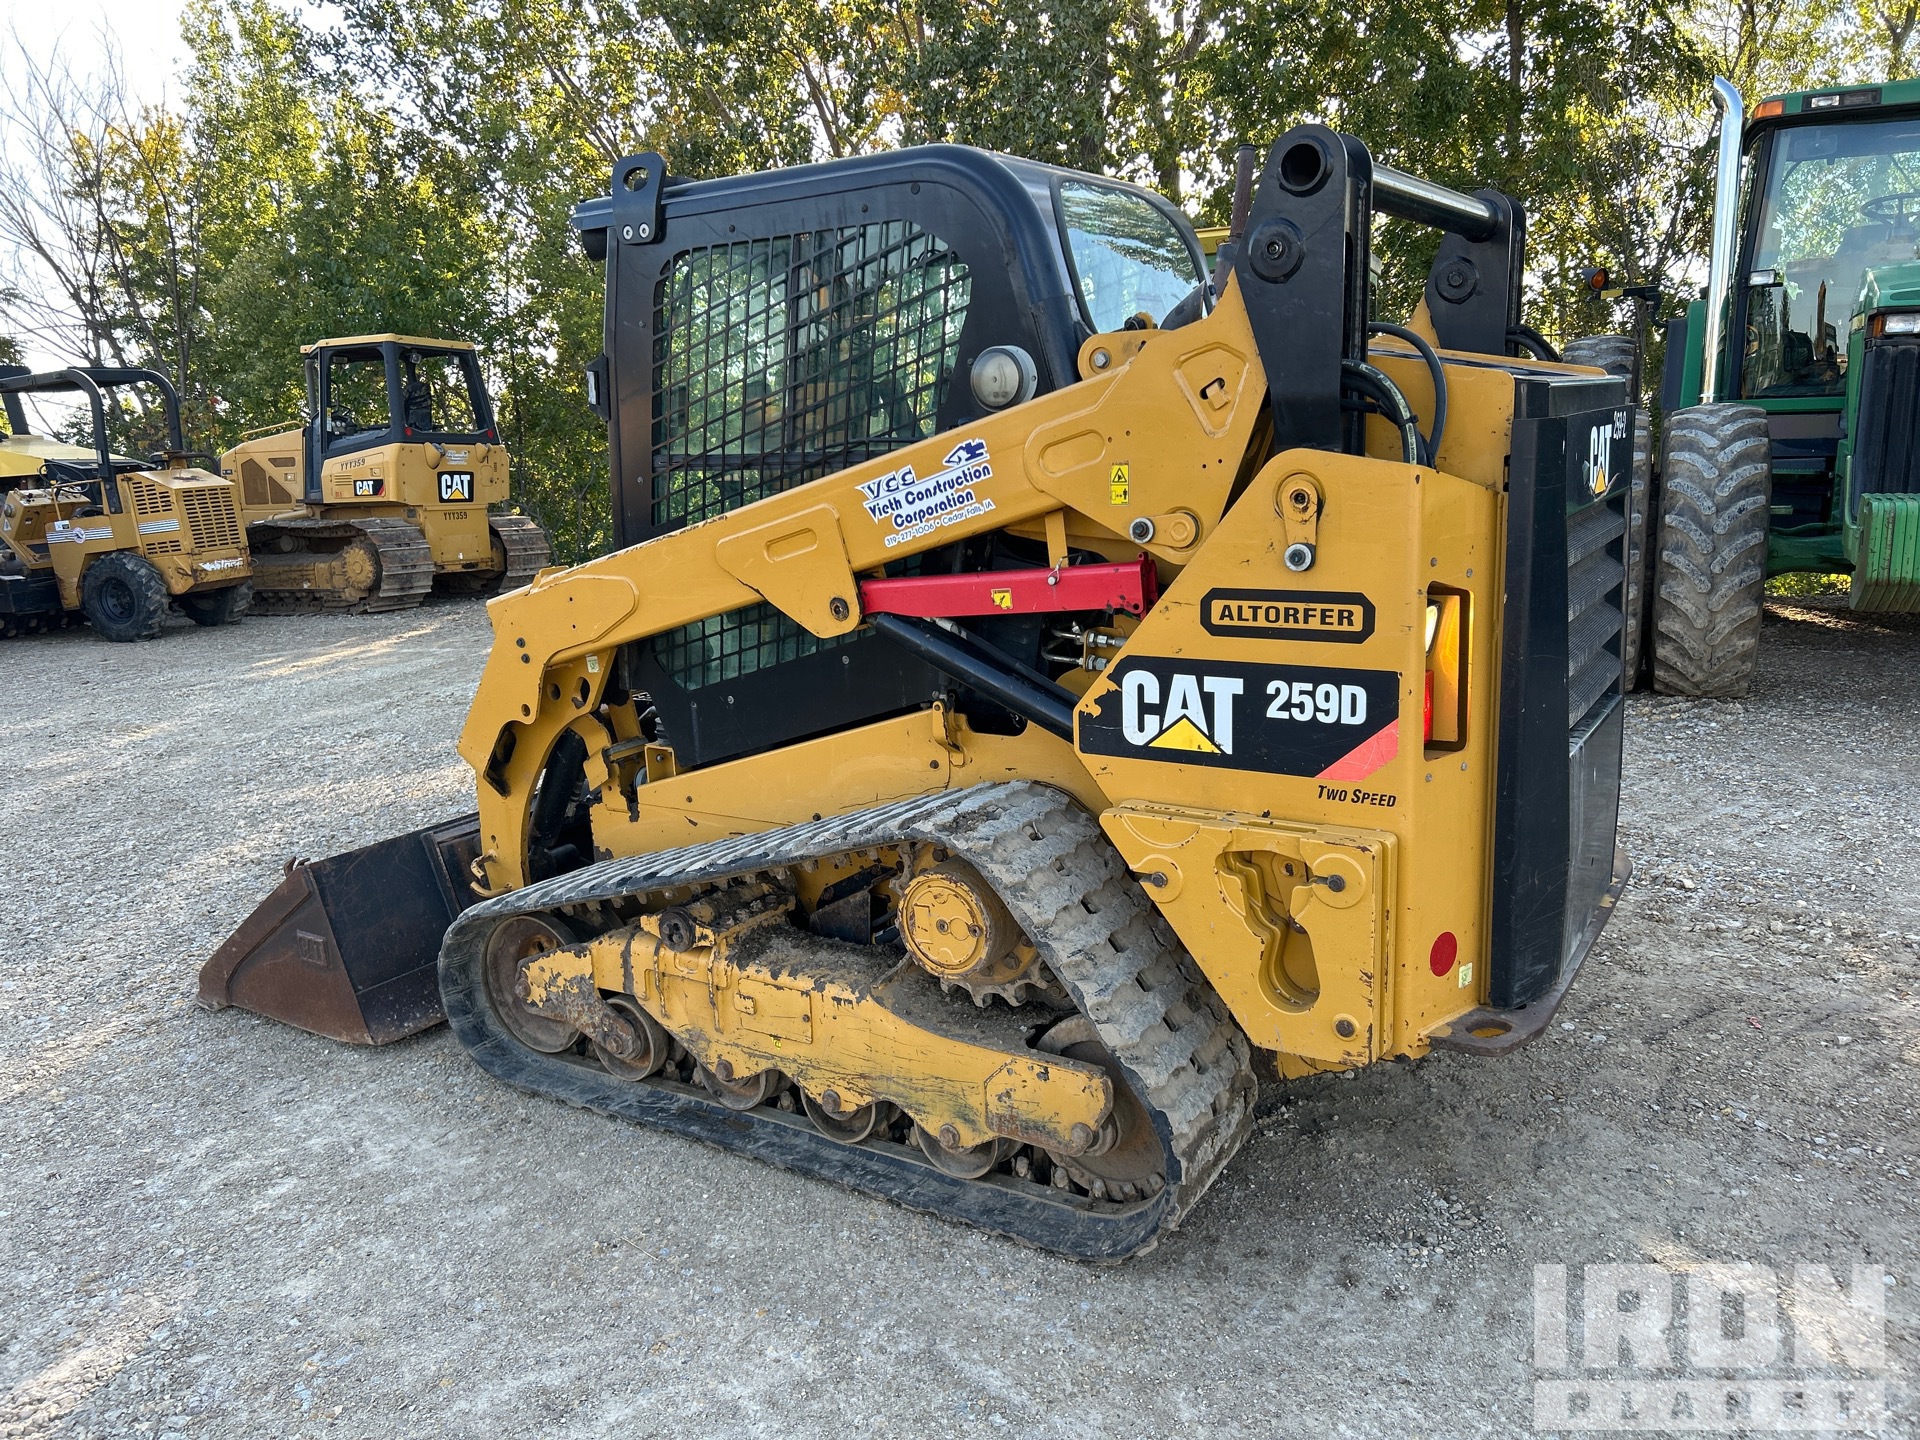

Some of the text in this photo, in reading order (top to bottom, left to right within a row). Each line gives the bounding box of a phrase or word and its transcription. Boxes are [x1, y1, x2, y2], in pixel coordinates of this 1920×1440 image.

[341, 457, 366, 471] YYY359
[1590, 424, 1612, 490] CAT
[356, 481, 374, 496] CAT
[441, 474, 471, 500] CAT
[861, 467, 916, 500] VCC
[868, 465, 991, 519] Vieth Construction
[443, 511, 468, 521] YYY359
[886, 523, 935, 546] 319-277-1006
[942, 512, 965, 525] Cedar
[985, 501, 994, 510] IA
[894, 490, 974, 528] Corporation
[1218, 604, 1355, 627] ALTORFER
[1122, 669, 1368, 755] CAT 259D
